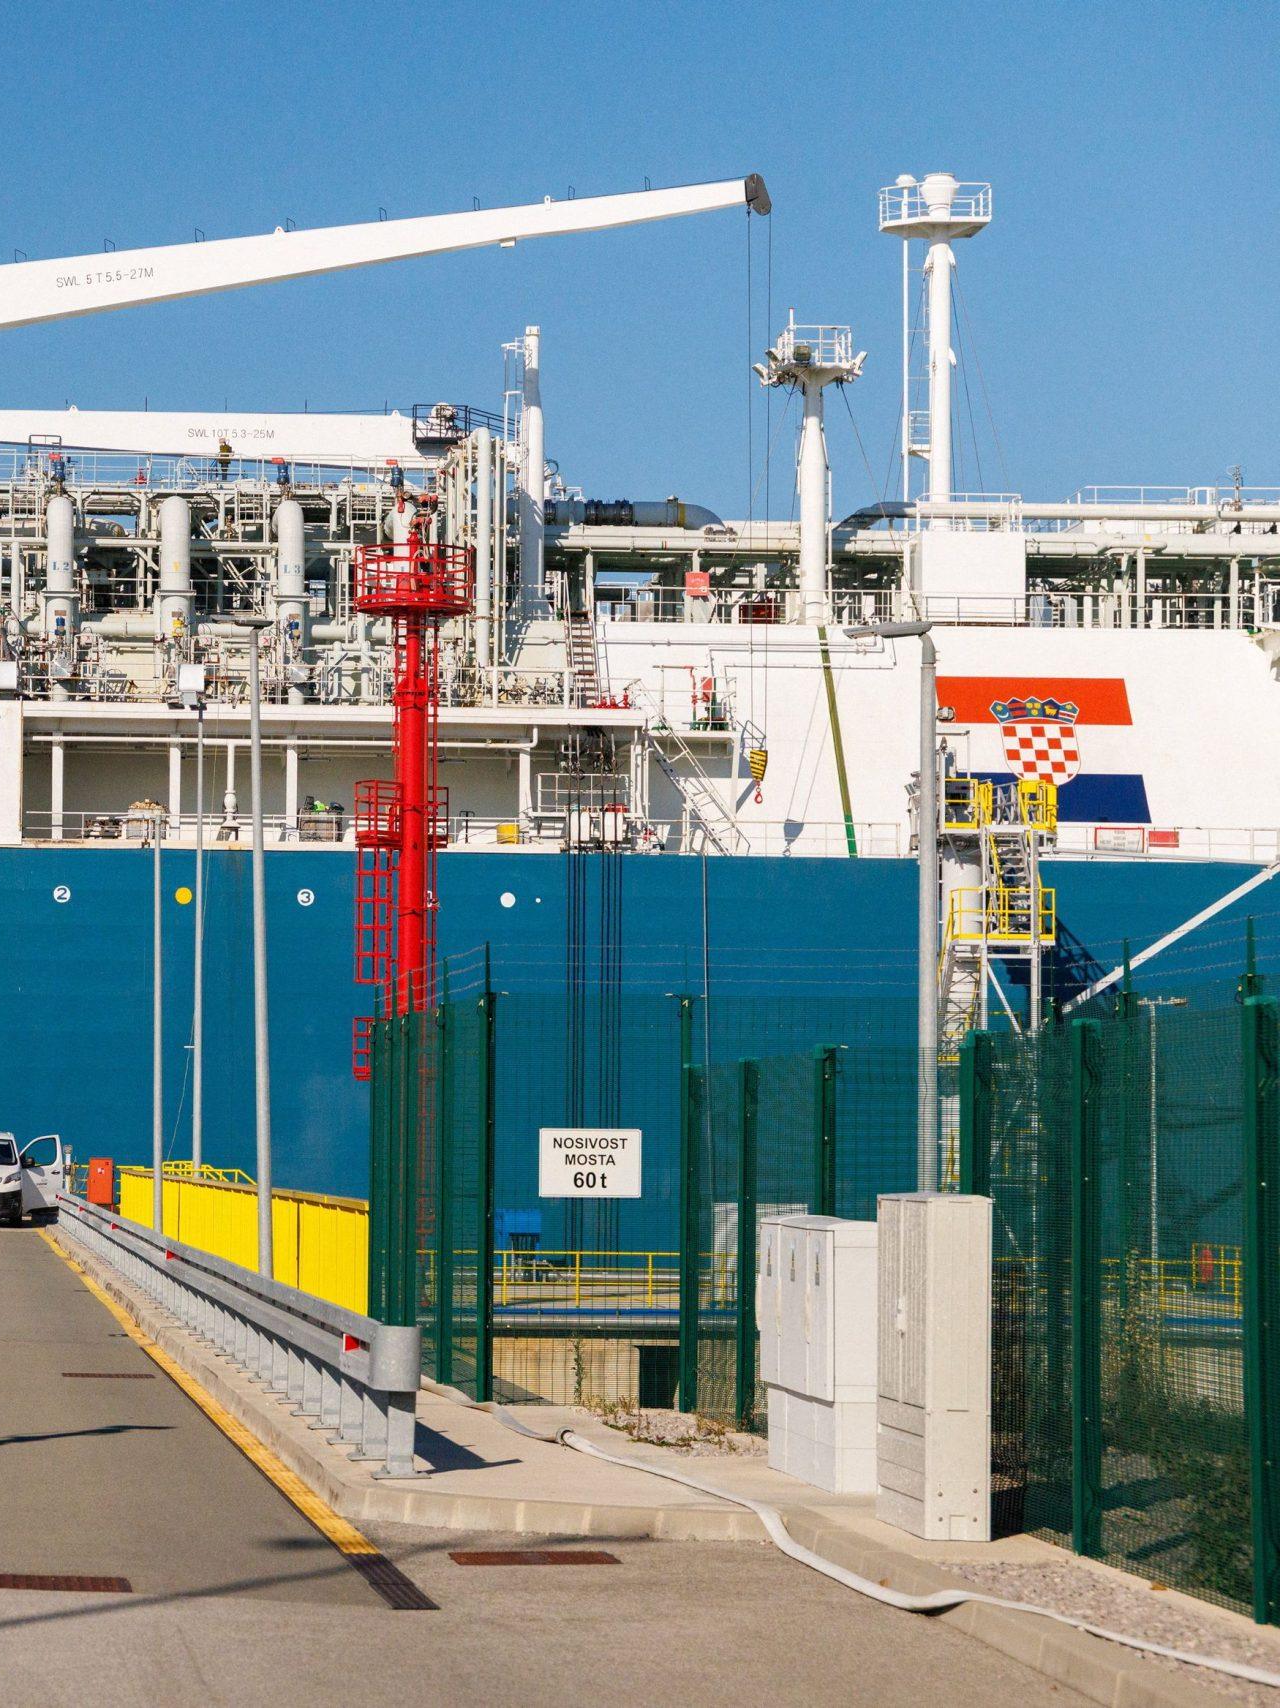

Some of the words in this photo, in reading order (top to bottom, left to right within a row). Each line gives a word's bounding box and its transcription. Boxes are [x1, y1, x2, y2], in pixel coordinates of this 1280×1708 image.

[56, 275, 80, 288] SWL
[187, 428, 209, 438] SWL
[56, 887, 68, 900] 2
[300, 891, 311, 904] 3
[553, 1137, 628, 1150] NOSIVOST
[564, 1153, 616, 1166] MOSTA
[573, 1171, 597, 1189] 60
[600, 1172, 608, 1189] t
